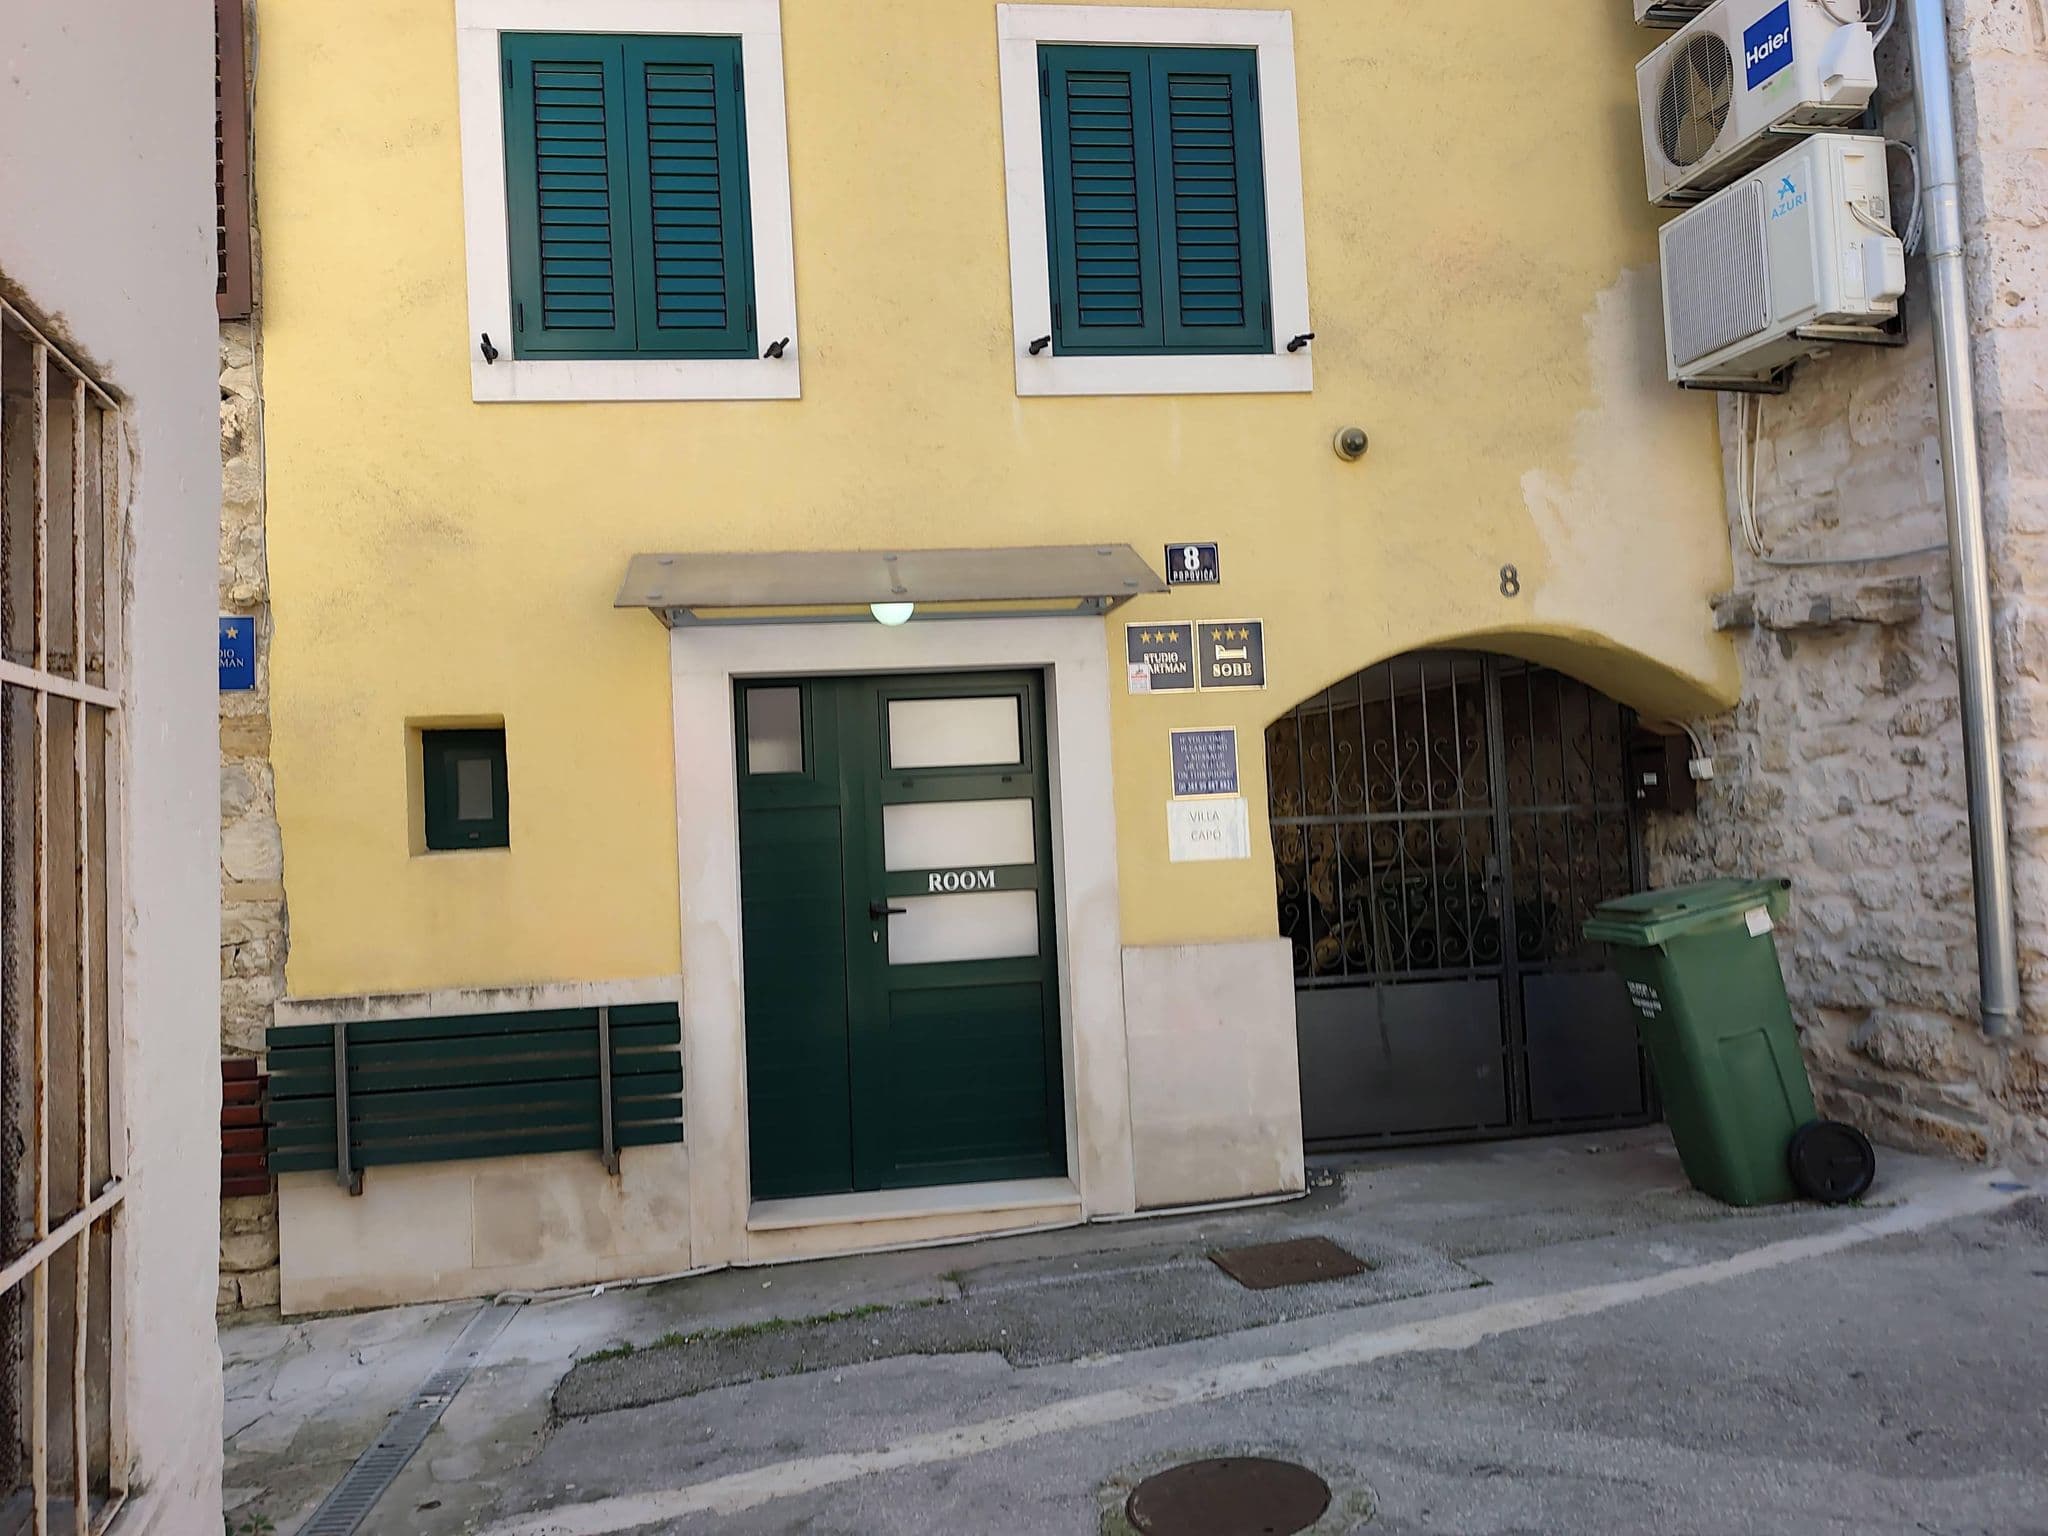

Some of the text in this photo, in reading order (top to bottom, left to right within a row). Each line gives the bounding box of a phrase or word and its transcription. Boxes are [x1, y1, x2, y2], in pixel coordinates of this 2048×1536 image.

[1746, 27, 1790, 69] Haier
[1771, 191, 1808, 221] AZURI
[1183, 546, 1200, 571] 8
[1499, 563, 1520, 598] 8
[1143, 652, 1178, 664] STUDIO
[1149, 661, 1187, 674] ARTMAN
[1213, 662, 1252, 677] SOBE
[1189, 810, 1220, 823] VILLA
[928, 869, 996, 892] ROOM
